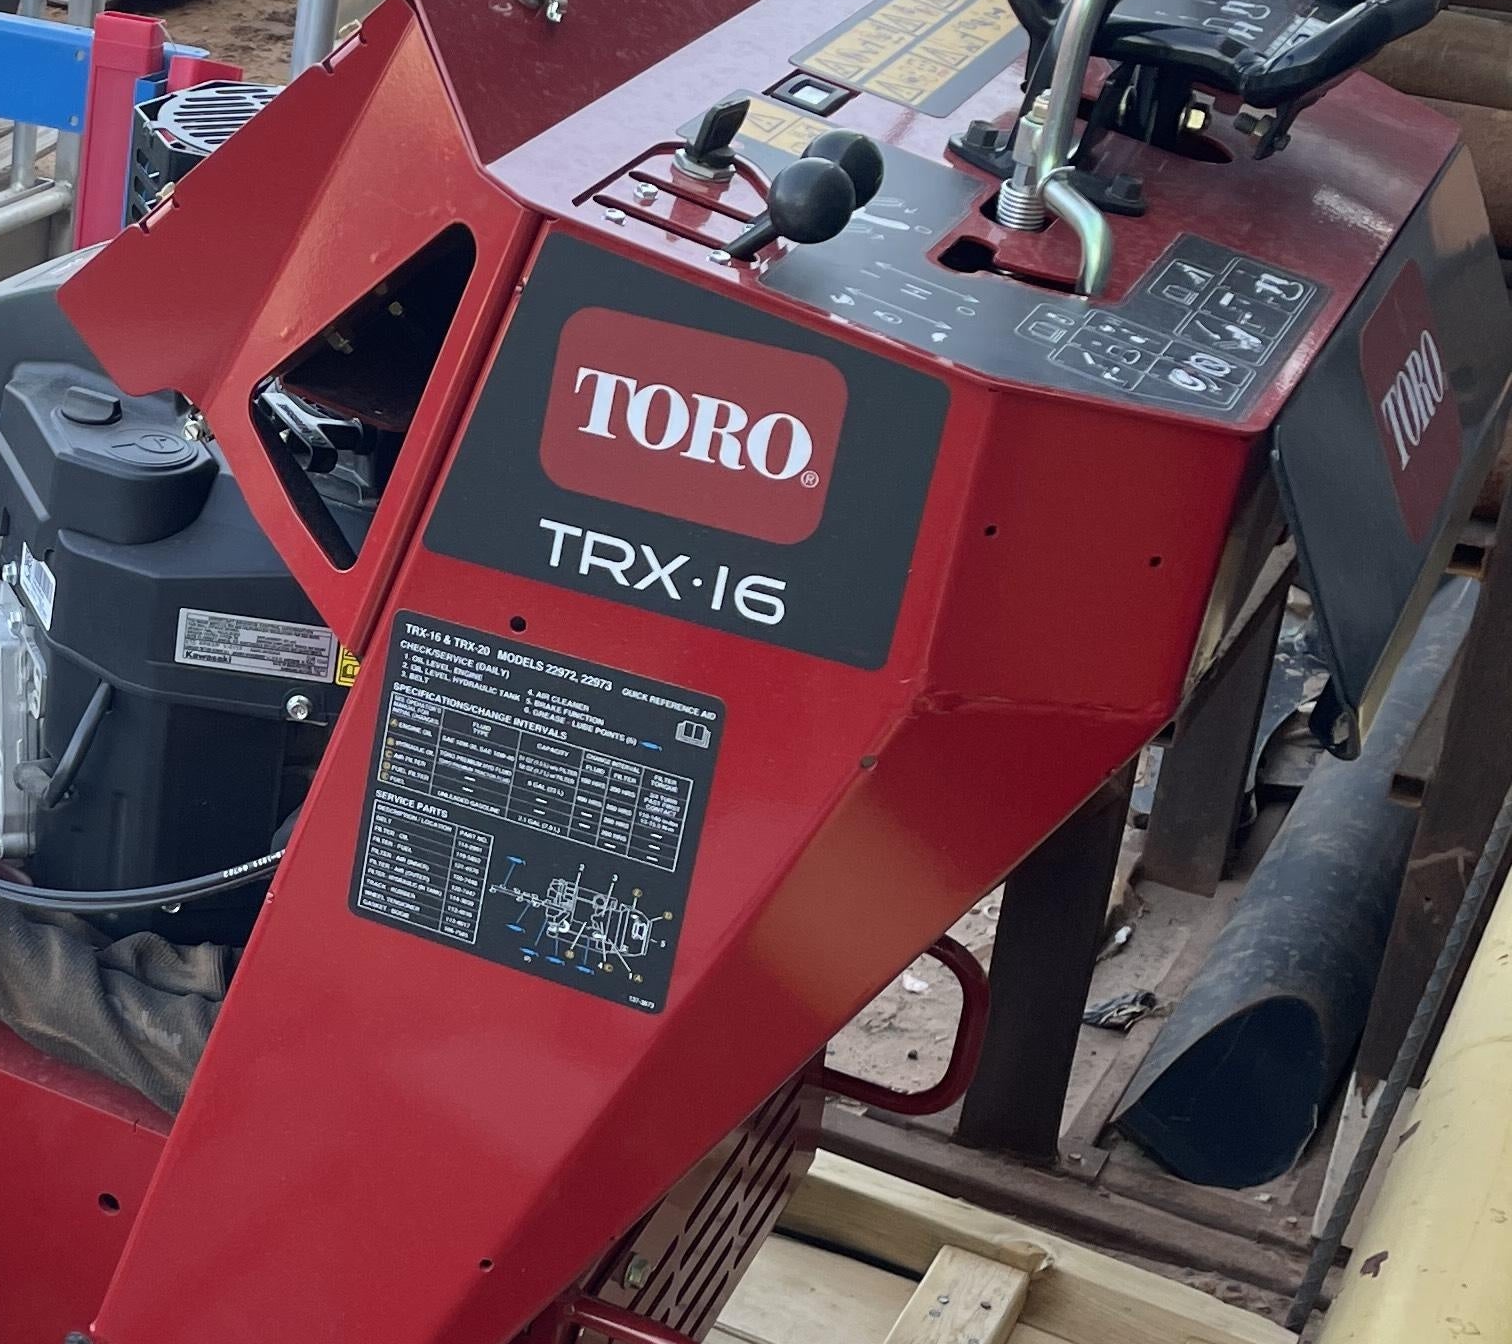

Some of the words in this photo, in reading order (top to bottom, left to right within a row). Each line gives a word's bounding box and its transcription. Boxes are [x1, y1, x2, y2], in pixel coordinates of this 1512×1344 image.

[1382, 330, 1444, 471] TORO
[185, 649, 232, 664] Kawasaki
[399, 639, 474, 668] CHECK/SERVICE
[474, 660, 510, 679] (DAILY)
[404, 623, 442, 642] TRX-16
[443, 634, 451, 645] &
[452, 637, 490, 656] TRX-20
[496, 649, 544, 671] MODELS
[580, 673, 613, 691] 22973
[411, 654, 424, 664] OIL
[453, 666, 483, 681] ENGINE
[408, 672, 429, 684] BELT
[410, 664, 423, 673] OIL
[452, 676, 497, 695] HYDRAULIC
[499, 689, 520, 701] TANK
[393, 681, 512, 723] SPECIFICATIONS/CHANGE
[512, 716, 567, 740] INTERVALS
[534, 700, 561, 713] BRAKE
[562, 708, 604, 726] FUNCTION
[535, 691, 550, 700] AIR
[551, 695, 589, 712] CLEANER
[621, 687, 648, 702] QUICK
[649, 695, 699, 716] REFERENCE
[700, 709, 716, 721] AID
[532, 709, 565, 723] GREASE
[571, 720, 593, 732] LUBE
[594, 726, 625, 741] POINTS
[375, 789, 415, 808] SERVICE
[416, 801, 448, 818] PARTS
